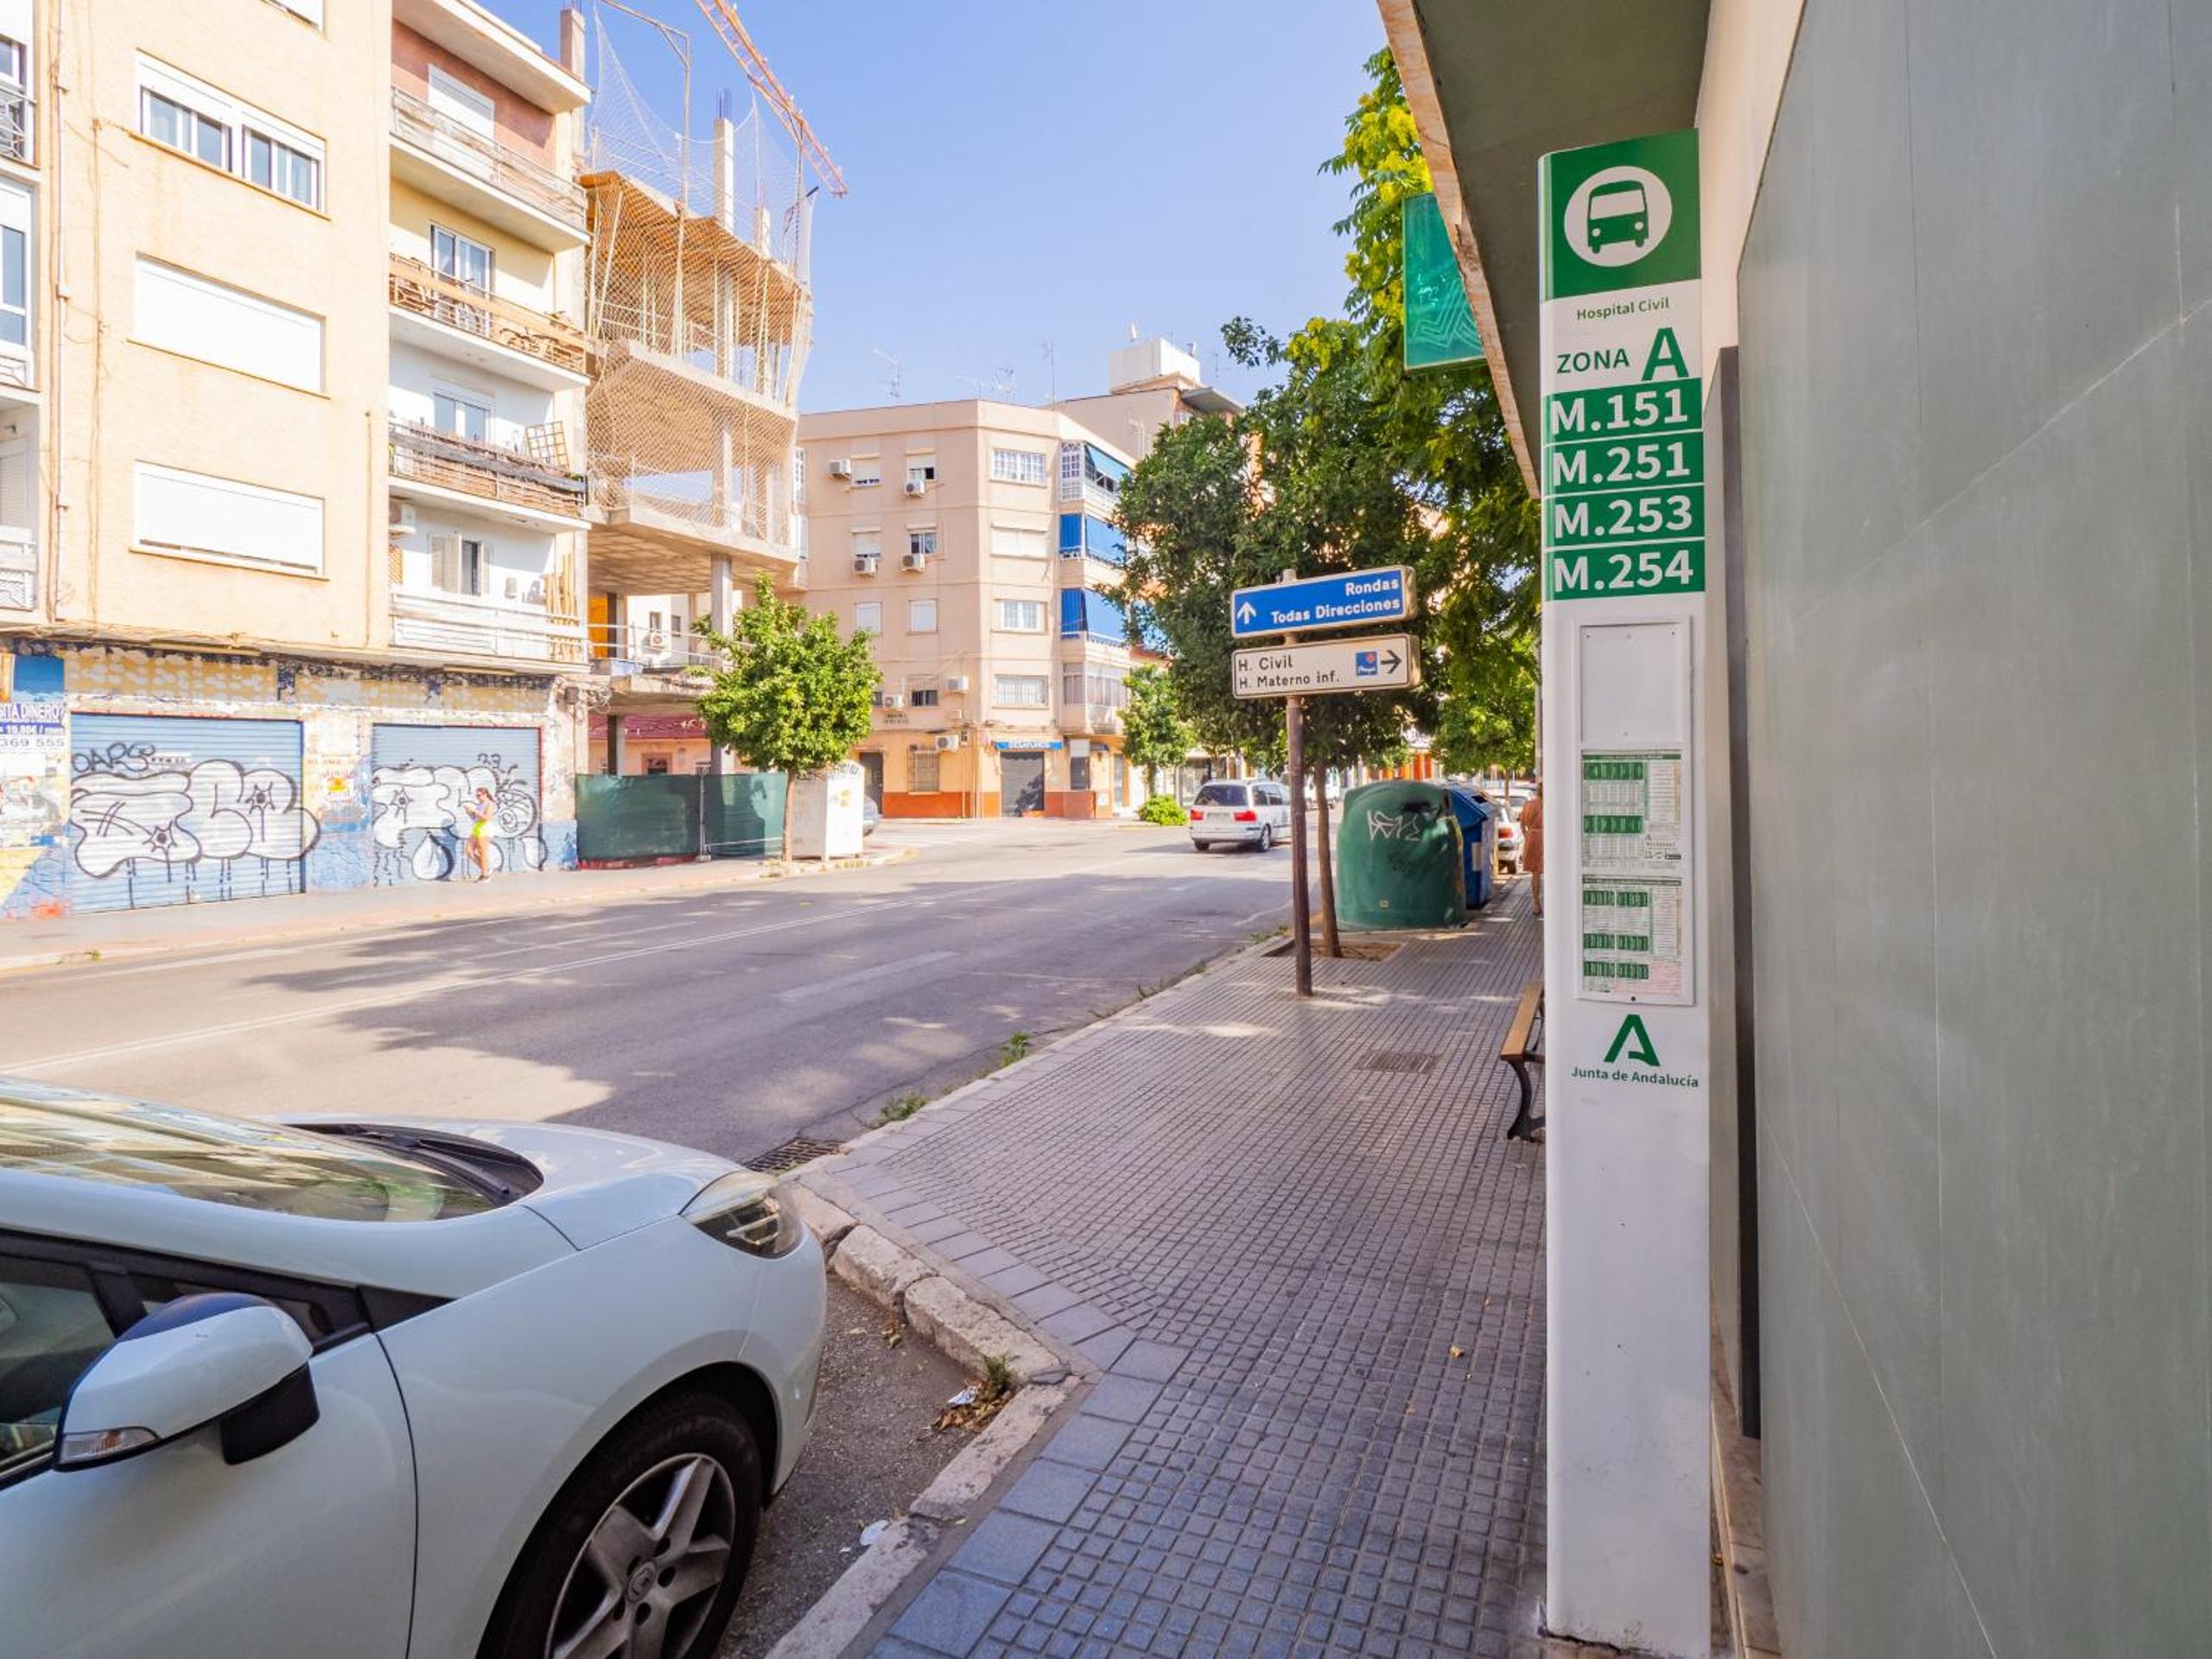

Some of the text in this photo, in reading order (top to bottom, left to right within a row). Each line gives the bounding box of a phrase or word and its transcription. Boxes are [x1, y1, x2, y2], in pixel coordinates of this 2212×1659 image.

[1577, 297, 1670, 321] Hospital Civil
[1557, 327, 1689, 381] ZONA A
[1552, 389, 1688, 435] M.151
[1553, 442, 1691, 486] M.251
[1554, 495, 1693, 539] M.253
[1554, 550, 1694, 593] M.254
[1345, 579, 1400, 596] Rondas
[1271, 599, 1400, 624] Todas Direcciones
[1238, 654, 1293, 671] H. Civil
[1239, 671, 1340, 689] H. Materno inf.
[1572, 1066, 1699, 1088] Junta de Andalucía
